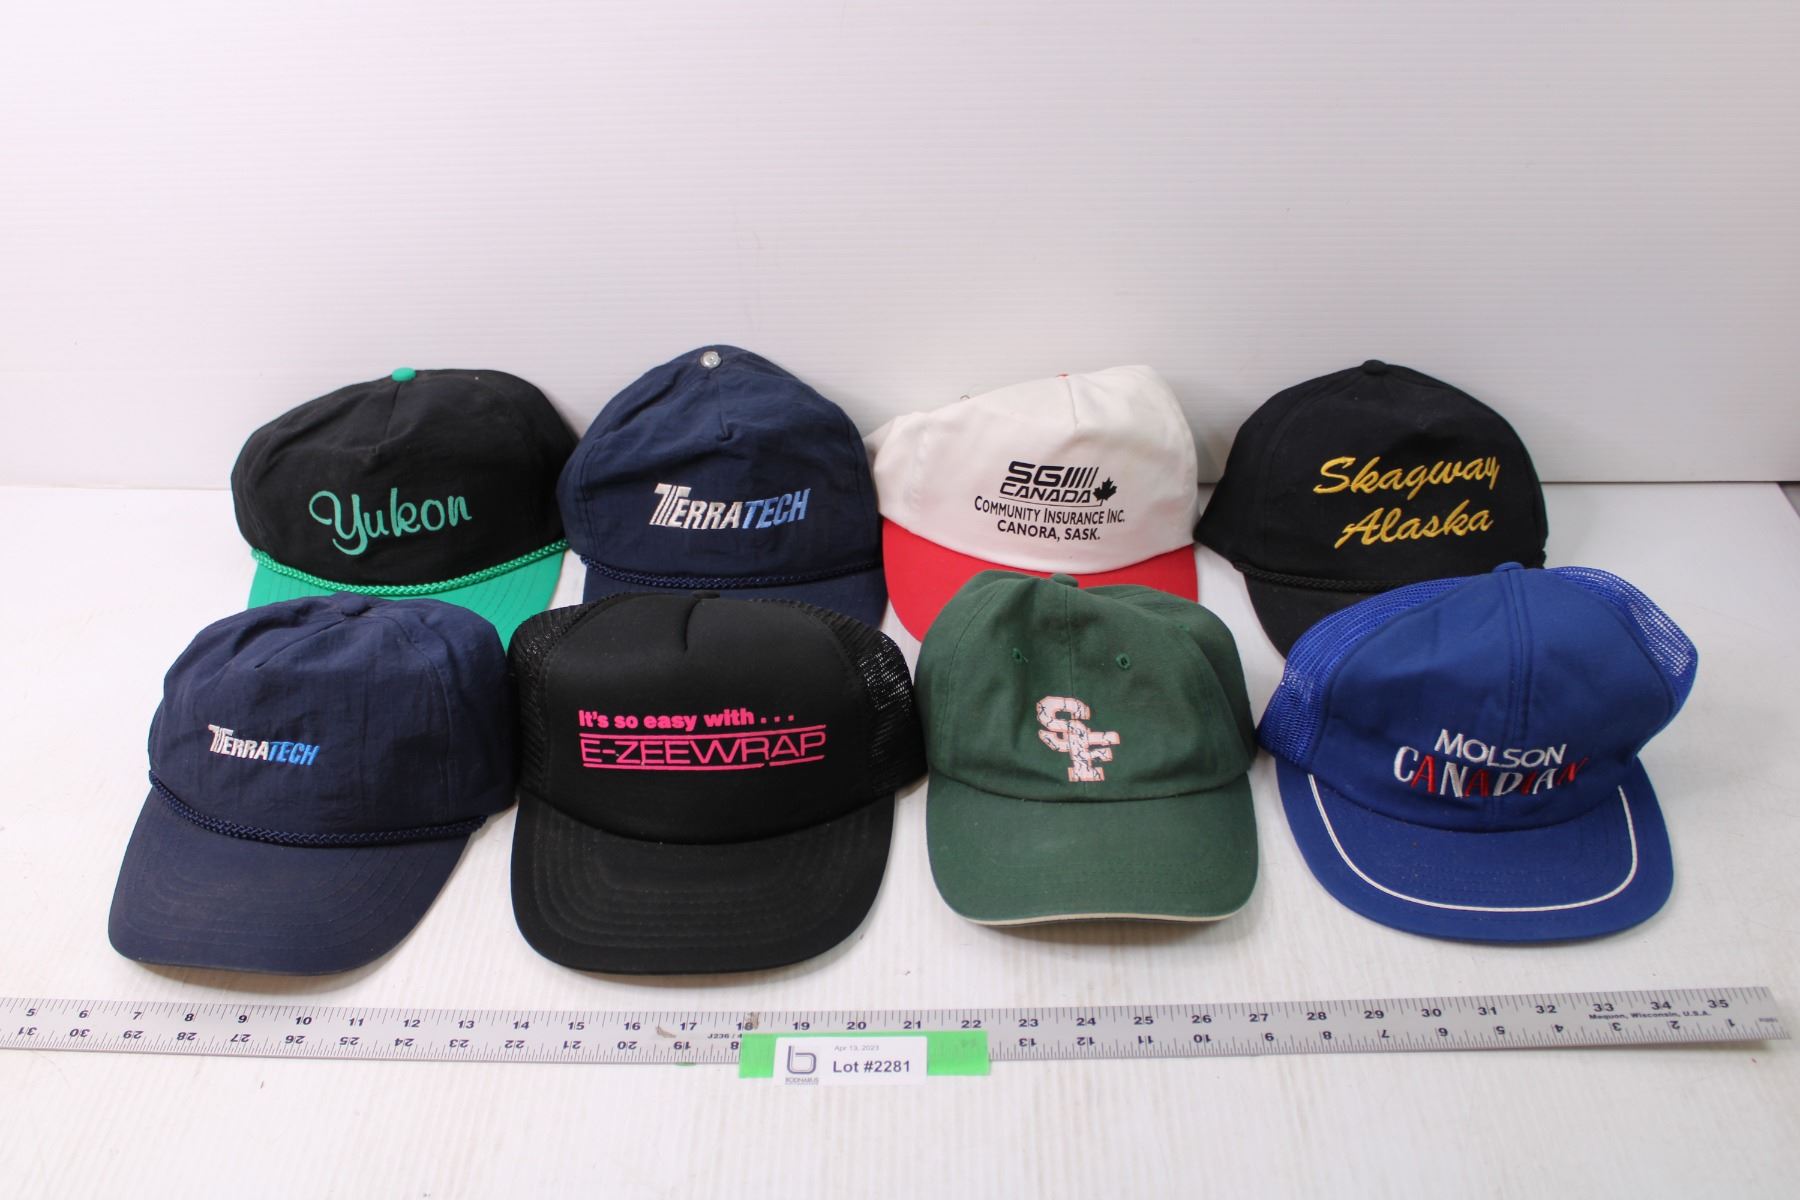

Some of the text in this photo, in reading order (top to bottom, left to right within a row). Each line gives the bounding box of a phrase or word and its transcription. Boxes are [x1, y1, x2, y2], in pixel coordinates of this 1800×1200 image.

[1313, 456, 1500, 500] Skagway
[1000, 482, 1092, 503] CANADA
[974, 495, 1125, 525] COMMUNITY INSURANCE INC.
[308, 487, 472, 556] Yukon
[1334, 499, 1494, 549] Alaska
[997, 520, 1101, 542] CANORA, SASK.
[578, 710, 609, 728] It's
[614, 714, 638, 729] so
[643, 713, 698, 732] easy
[580, 731, 827, 764] E-ZEEWRAP
[1434, 728, 1567, 768] MOLSON
[1393, 746, 1590, 798] CANADIAN
[26, 1008, 36, 1017] 5
[79, 1010, 89, 1019] 6
[133, 1012, 142, 1020] 7
[184, 1013, 194, 1022] 8
[238, 1014, 247, 1023] 9
[295, 1016, 312, 1025] 10
[349, 1018, 364, 1026] 11
[403, 1019, 421, 1028] 12
[458, 1020, 475, 1029] 13
[513, 1021, 530, 1030] 14
[568, 1022, 585, 1031] 15
[624, 1022, 641, 1031] 16
[680, 1022, 697, 1031] 17
[793, 1022, 810, 1031] 19
[846, 1021, 867, 1030] 20
[904, 1020, 922, 1029] 21
[961, 1020, 982, 1029] 22
[1018, 1018, 1039, 1028] 23
[1076, 1017, 1096, 1026] 24
[1134, 1016, 1154, 1025] 25
[1191, 1014, 1212, 1024] 26
[1249, 1013, 1269, 1022] 27
[1307, 1012, 1327, 1021] 28
[1364, 1010, 1385, 1019] 29
[1421, 1008, 1442, 1018] 30
[1478, 1007, 1497, 1016] 31
[1535, 1005, 1557, 1014] 32
[1592, 1003, 1615, 1012] 33
[1651, 1001, 1672, 1010] 34
[1707, 1000, 1729, 1008] 35
[1612, 1022, 1622, 1032] 3
[1670, 1020, 1680, 1030] 2
[1728, 1019, 1735, 1027] 1
[18, 1027, 37, 1036] 31
[69, 1028, 90, 1038] 30
[1438, 1027, 1448, 1036] 6
[1495, 1026, 1506, 1035] 5
[1554, 1024, 1564, 1033] 4
[123, 1030, 144, 1039] 29
[177, 1032, 197, 1041] 28
[230, 1033, 251, 1043] 27
[1193, 1034, 1212, 1043] 10
[1264, 1032, 1275, 1042] 9
[1322, 1031, 1332, 1040] 8
[1381, 1029, 1390, 1039] 7
[285, 1035, 305, 1044] 26
[339, 1036, 360, 1046] 25
[394, 1037, 415, 1047] 24
[449, 1039, 469, 1048] 23
[504, 1040, 525, 1048] 22
[563, 1040, 582, 1049] 21
[1019, 1038, 1037, 1047] 13
[1077, 1037, 1095, 1046] 12
[1138, 1035, 1154, 1044] 11
[617, 1041, 638, 1050] 20
[673, 1041, 691, 1050] 19
[833, 1060, 910, 1073] Lot #2281
